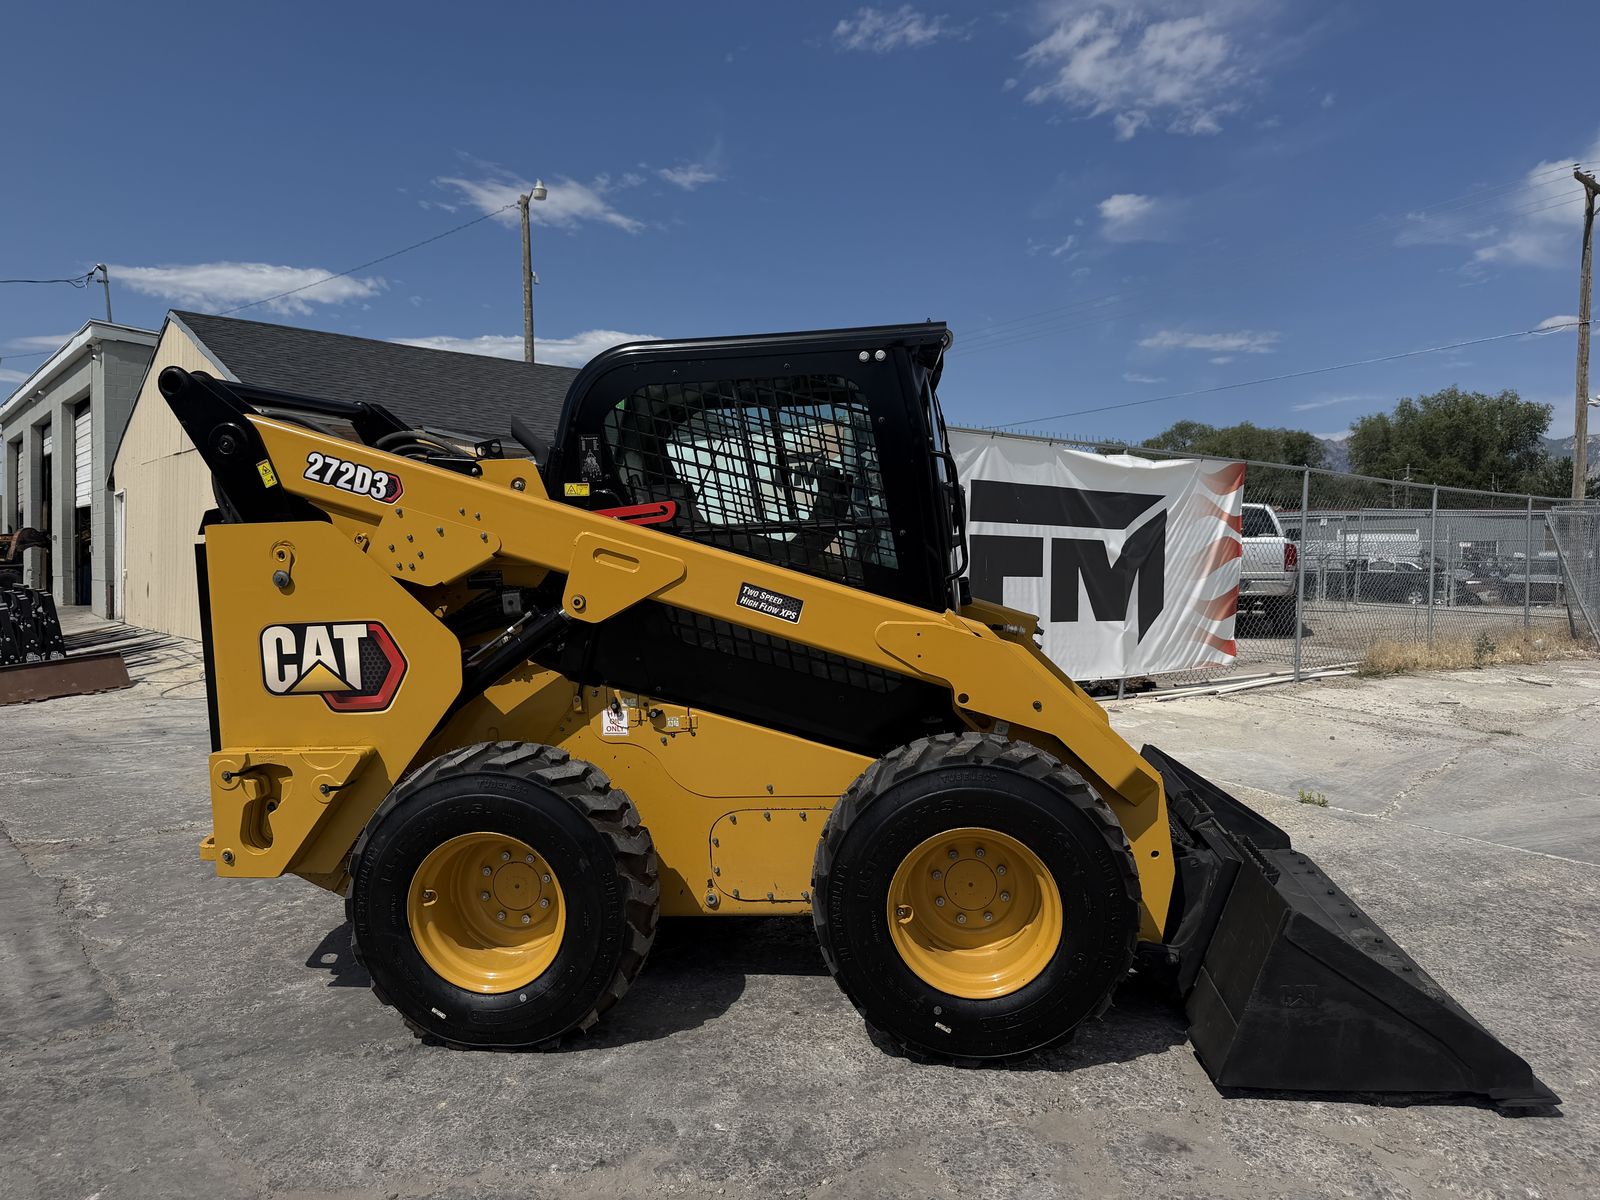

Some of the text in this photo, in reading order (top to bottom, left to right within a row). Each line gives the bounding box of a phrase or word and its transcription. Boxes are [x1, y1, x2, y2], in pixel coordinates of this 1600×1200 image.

[304, 453, 389, 499] 272D3
[742, 586, 783, 605] TWO SPEED
[740, 596, 797, 620] HIGH FLOW XPS
[262, 623, 368, 693] CAT
[606, 725, 624, 733] ONLY
